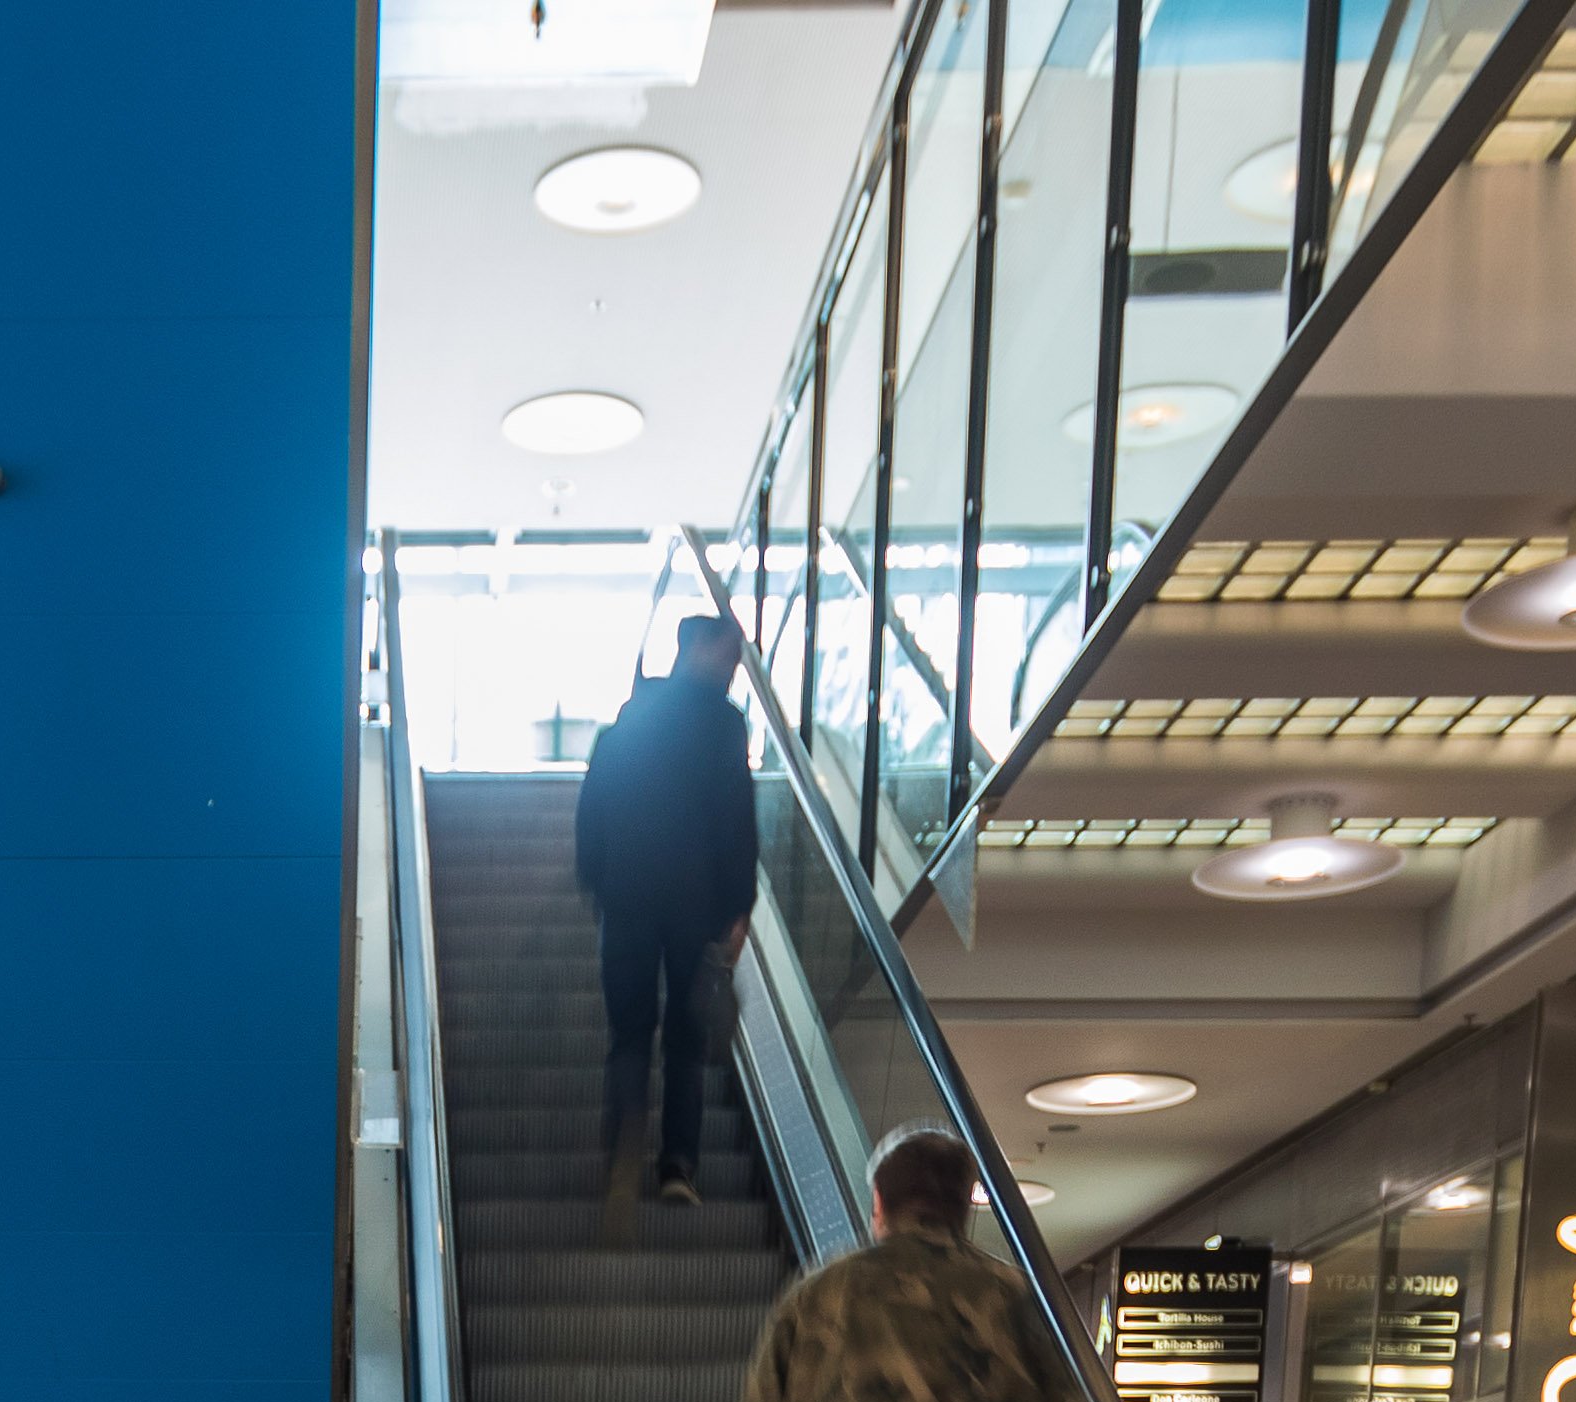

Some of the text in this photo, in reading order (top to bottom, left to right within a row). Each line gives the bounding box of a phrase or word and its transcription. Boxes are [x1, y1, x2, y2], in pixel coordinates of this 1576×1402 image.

[1124, 1271, 1260, 1294] QUICK & TASTY
[1194, 1313, 1224, 1323] House
